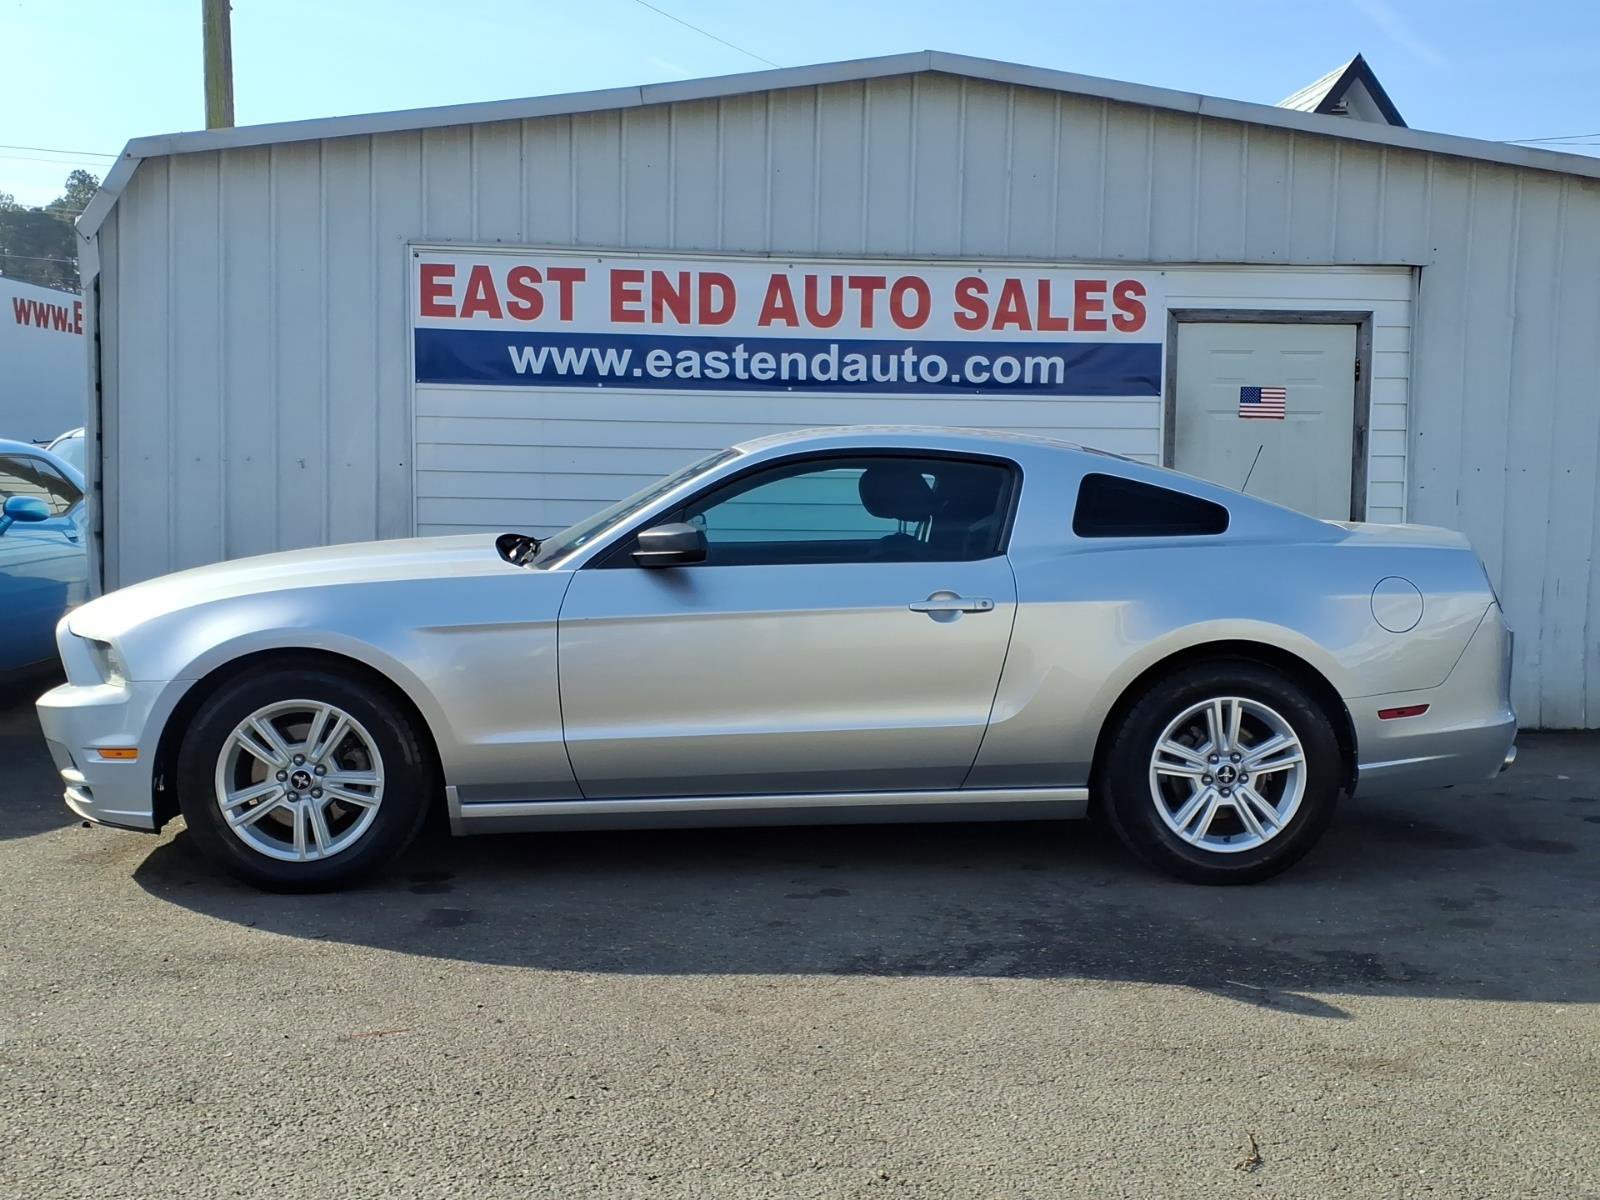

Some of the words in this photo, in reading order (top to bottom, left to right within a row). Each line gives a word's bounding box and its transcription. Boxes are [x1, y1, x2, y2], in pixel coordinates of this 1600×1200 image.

[419, 263, 586, 322] EAST
[609, 268, 737, 326] END
[757, 273, 932, 330] AUTO
[953, 276, 1147, 333] SALES
[507, 343, 1066, 385] www.eastendauto.com
